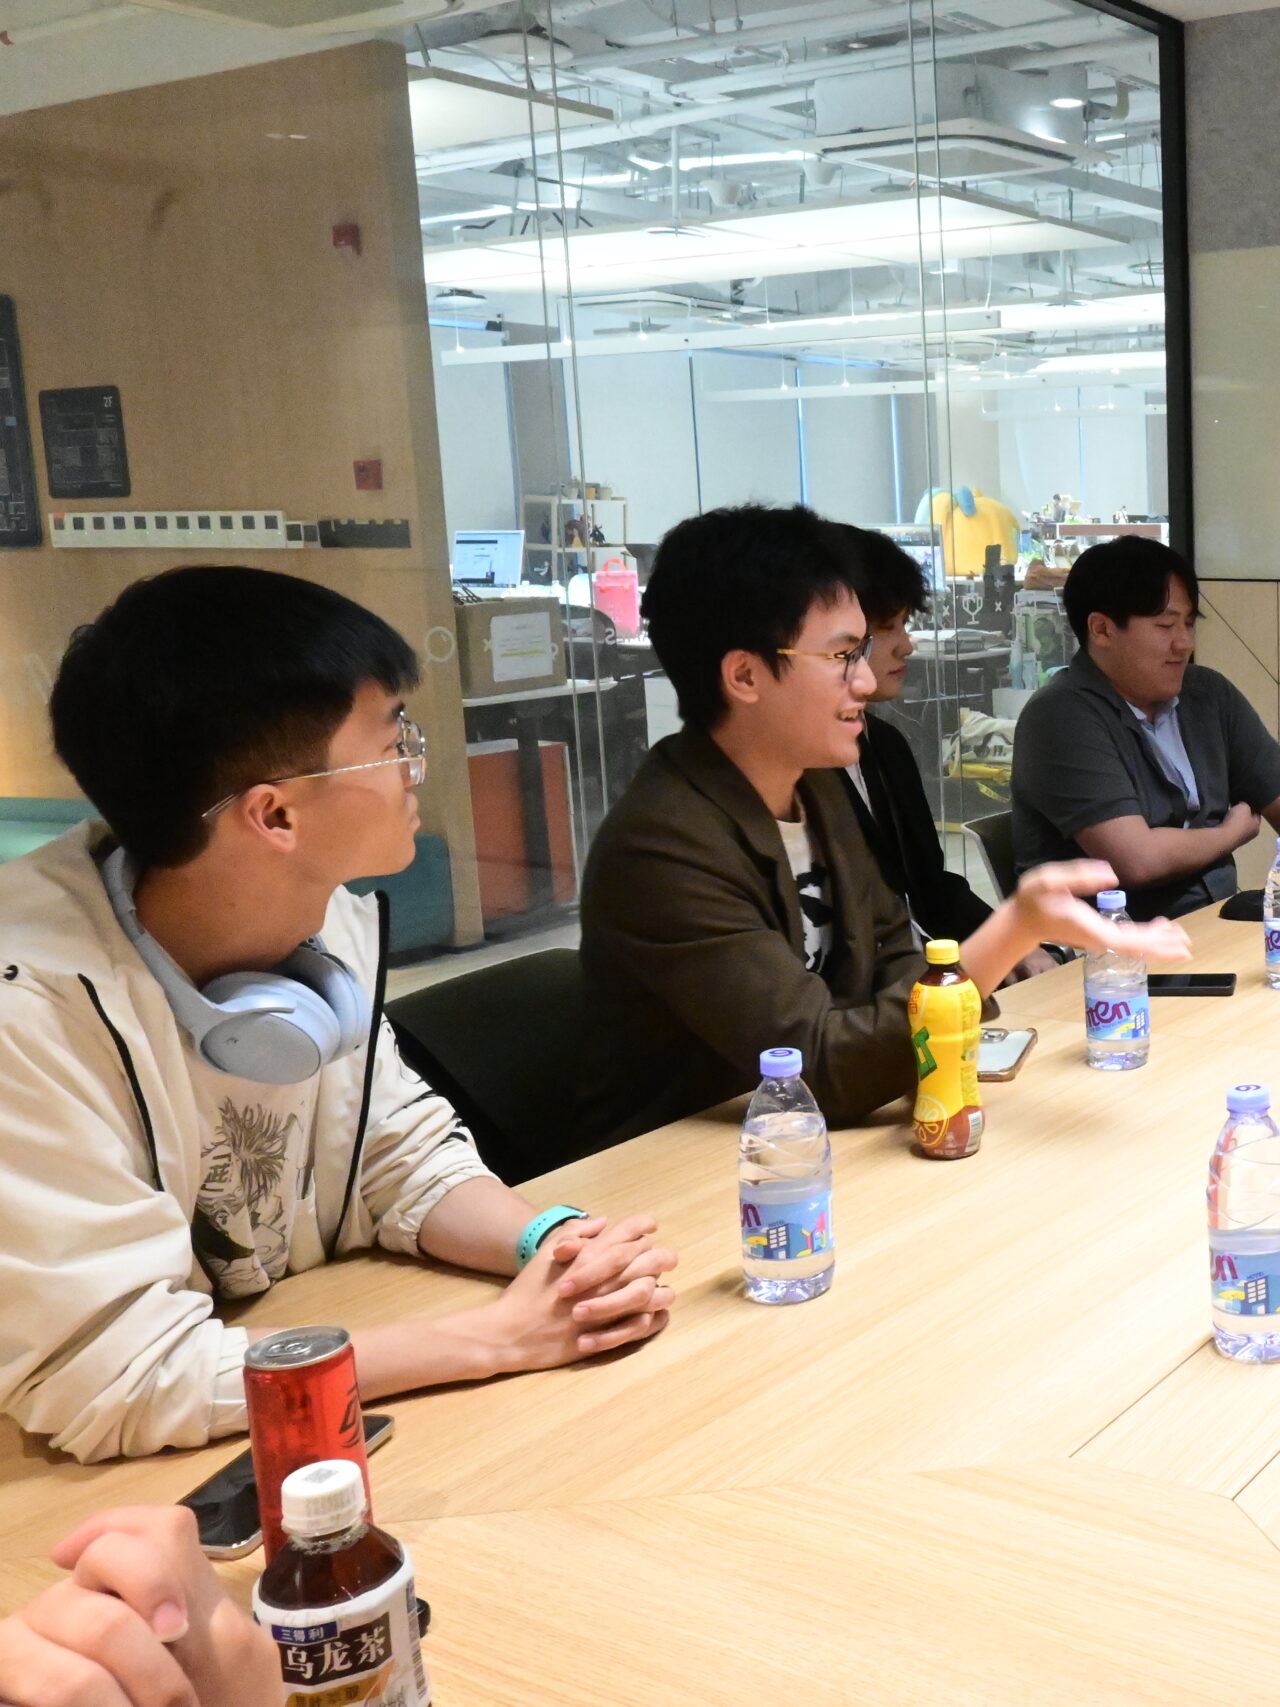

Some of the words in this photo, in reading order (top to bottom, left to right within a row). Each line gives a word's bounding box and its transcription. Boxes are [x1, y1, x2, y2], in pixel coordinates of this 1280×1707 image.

[281, 1627, 325, 1642] 三得利
[284, 1626, 386, 1680] 乌龙茶
